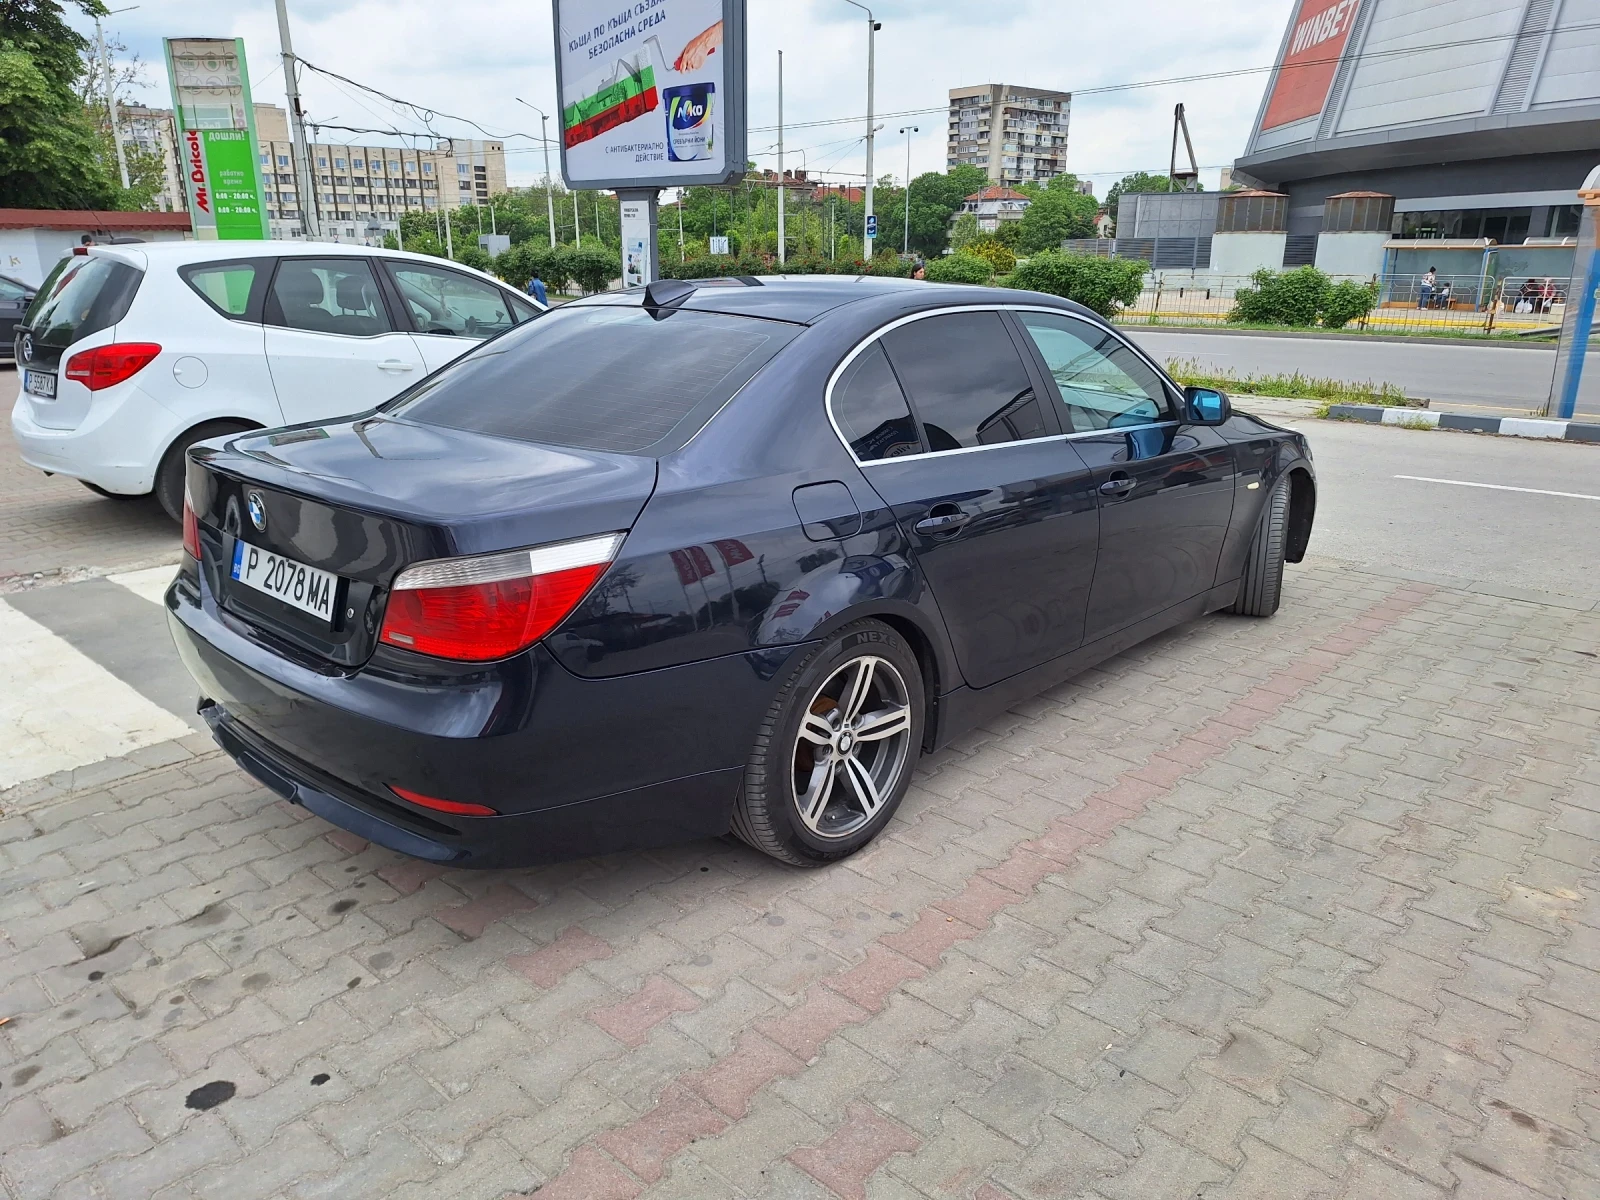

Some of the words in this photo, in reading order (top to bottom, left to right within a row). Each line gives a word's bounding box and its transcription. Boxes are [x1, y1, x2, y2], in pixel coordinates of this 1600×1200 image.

[568, 31, 592, 53] КЪЩА
[593, 24, 605, 39] ПО
[607, 9, 632, 32] КЪЩА
[634, 0, 665, 16] СЪЗД
[588, 26, 636, 60] БЕЗОПАСНА
[638, 9, 666, 33] СРЕДА
[1290, 0, 1358, 56] WINBET
[610, 142, 664, 153] АНТИБАКТЕРИАЛНО
[635, 152, 664, 162] ДЕЙСТВИЕ
[246, 547, 259, 580] P
[263, 555, 306, 602] 2078
[306, 572, 330, 615] MA
[856, 631, 902, 652] NEXE
